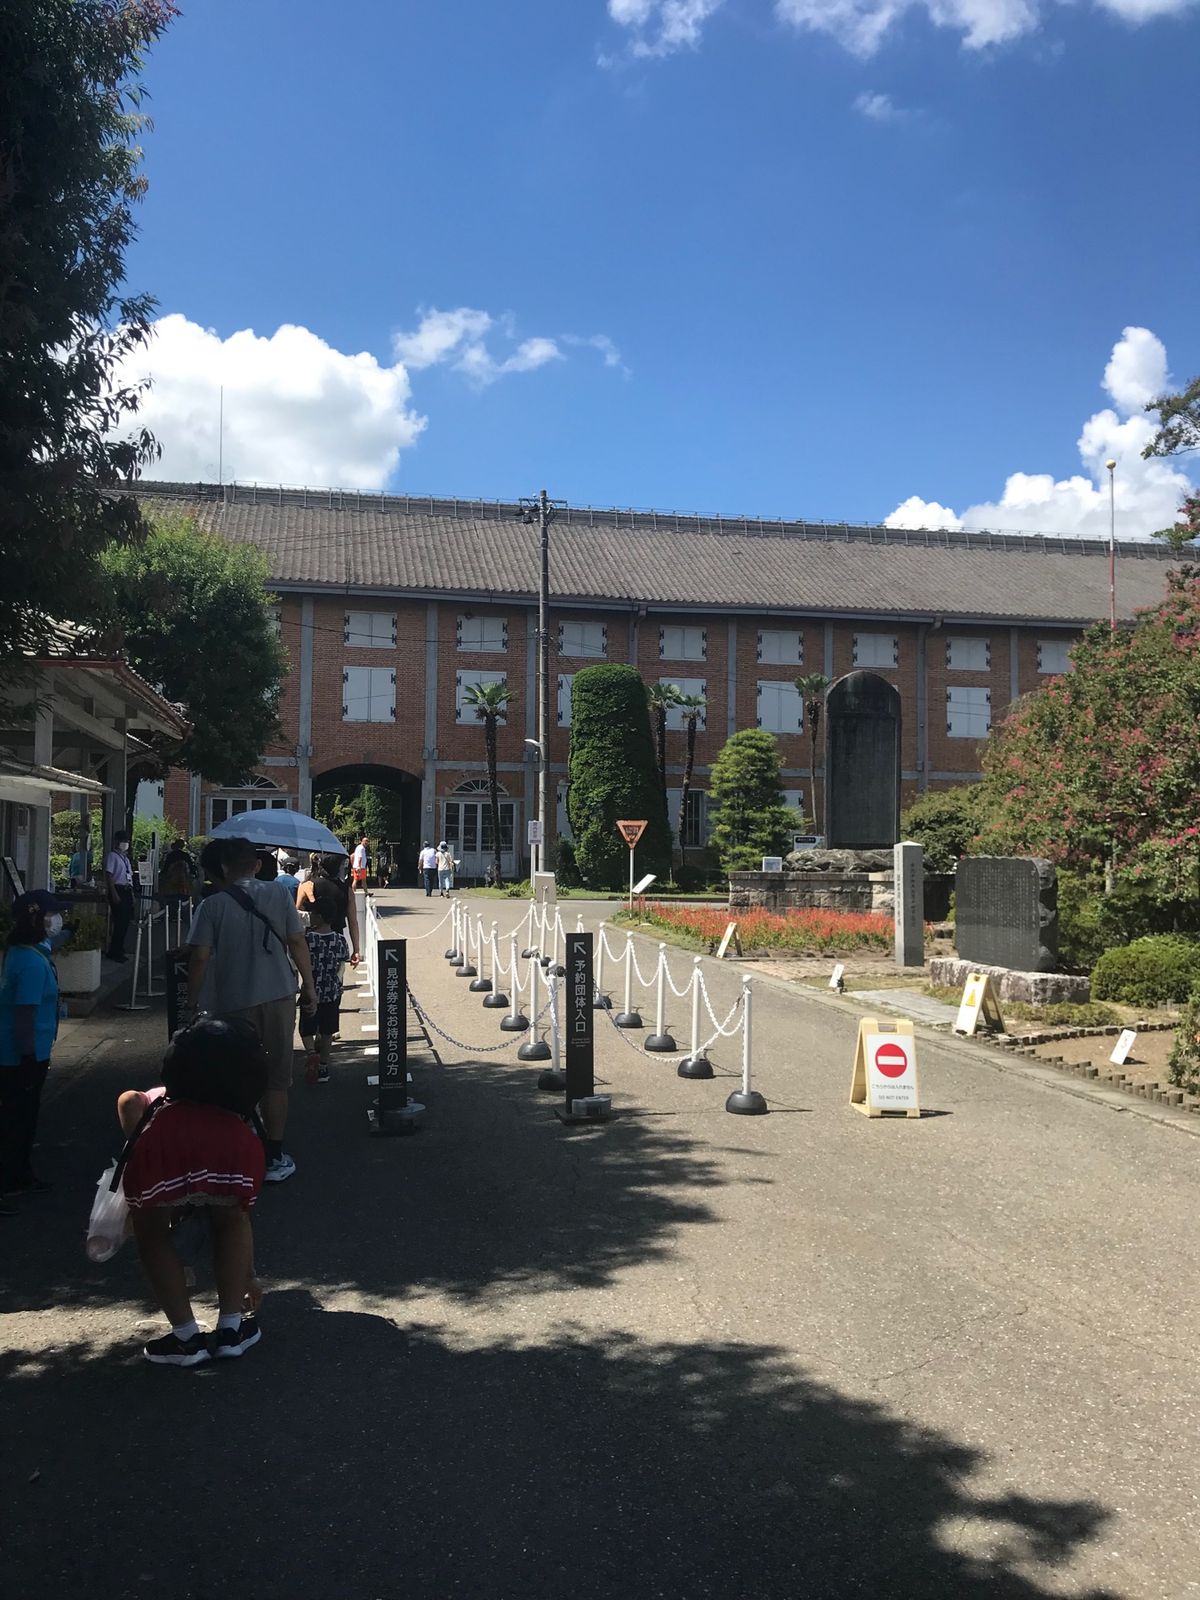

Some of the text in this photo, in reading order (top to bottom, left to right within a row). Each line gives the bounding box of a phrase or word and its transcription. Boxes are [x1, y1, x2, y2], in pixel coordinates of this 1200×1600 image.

[386, 967, 399, 1076] 見学券をお持ちの方
[574, 960, 586, 1032] 予約団体入口
